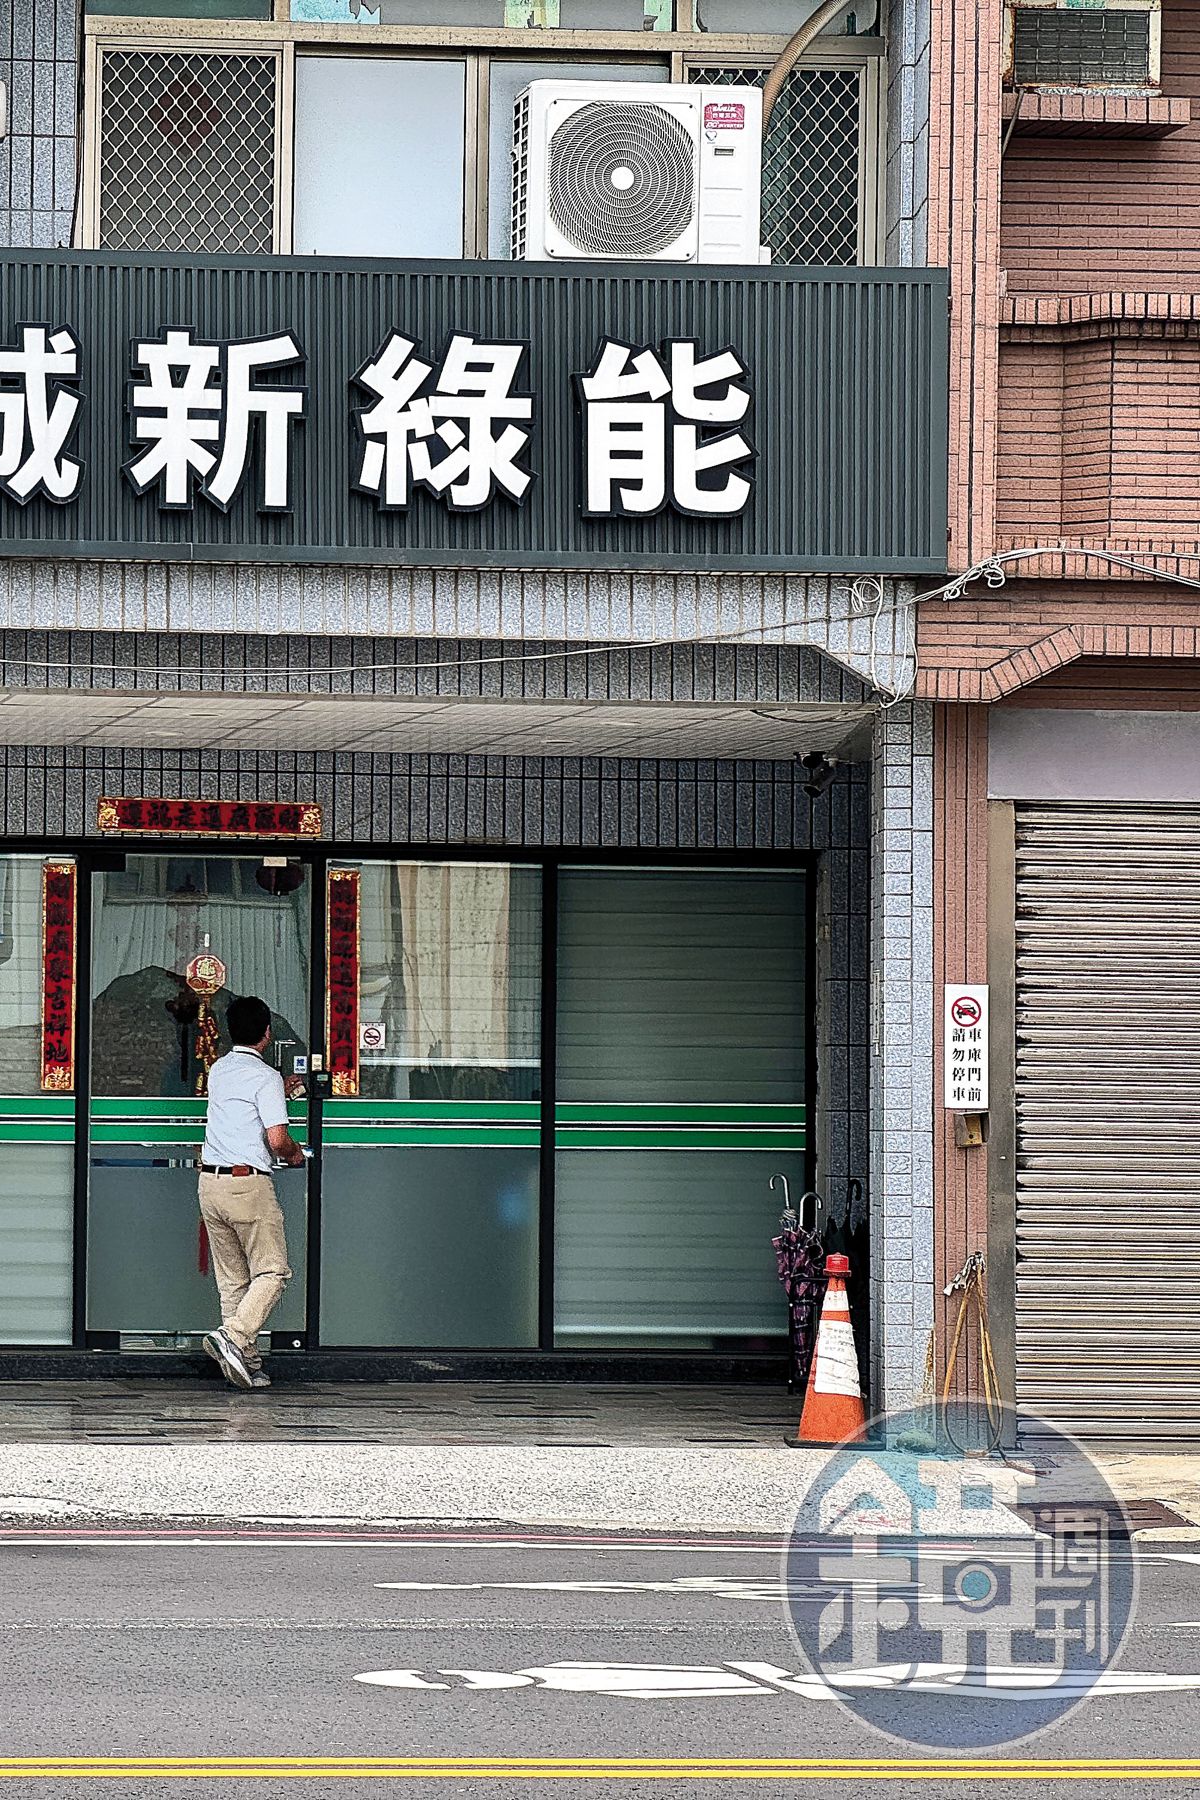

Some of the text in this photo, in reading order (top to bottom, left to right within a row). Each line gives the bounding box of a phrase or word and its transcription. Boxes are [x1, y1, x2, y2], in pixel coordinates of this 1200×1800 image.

[952, 1028, 966, 1102] 請勿停車
[968, 1028, 982, 1102] 車庫門前
